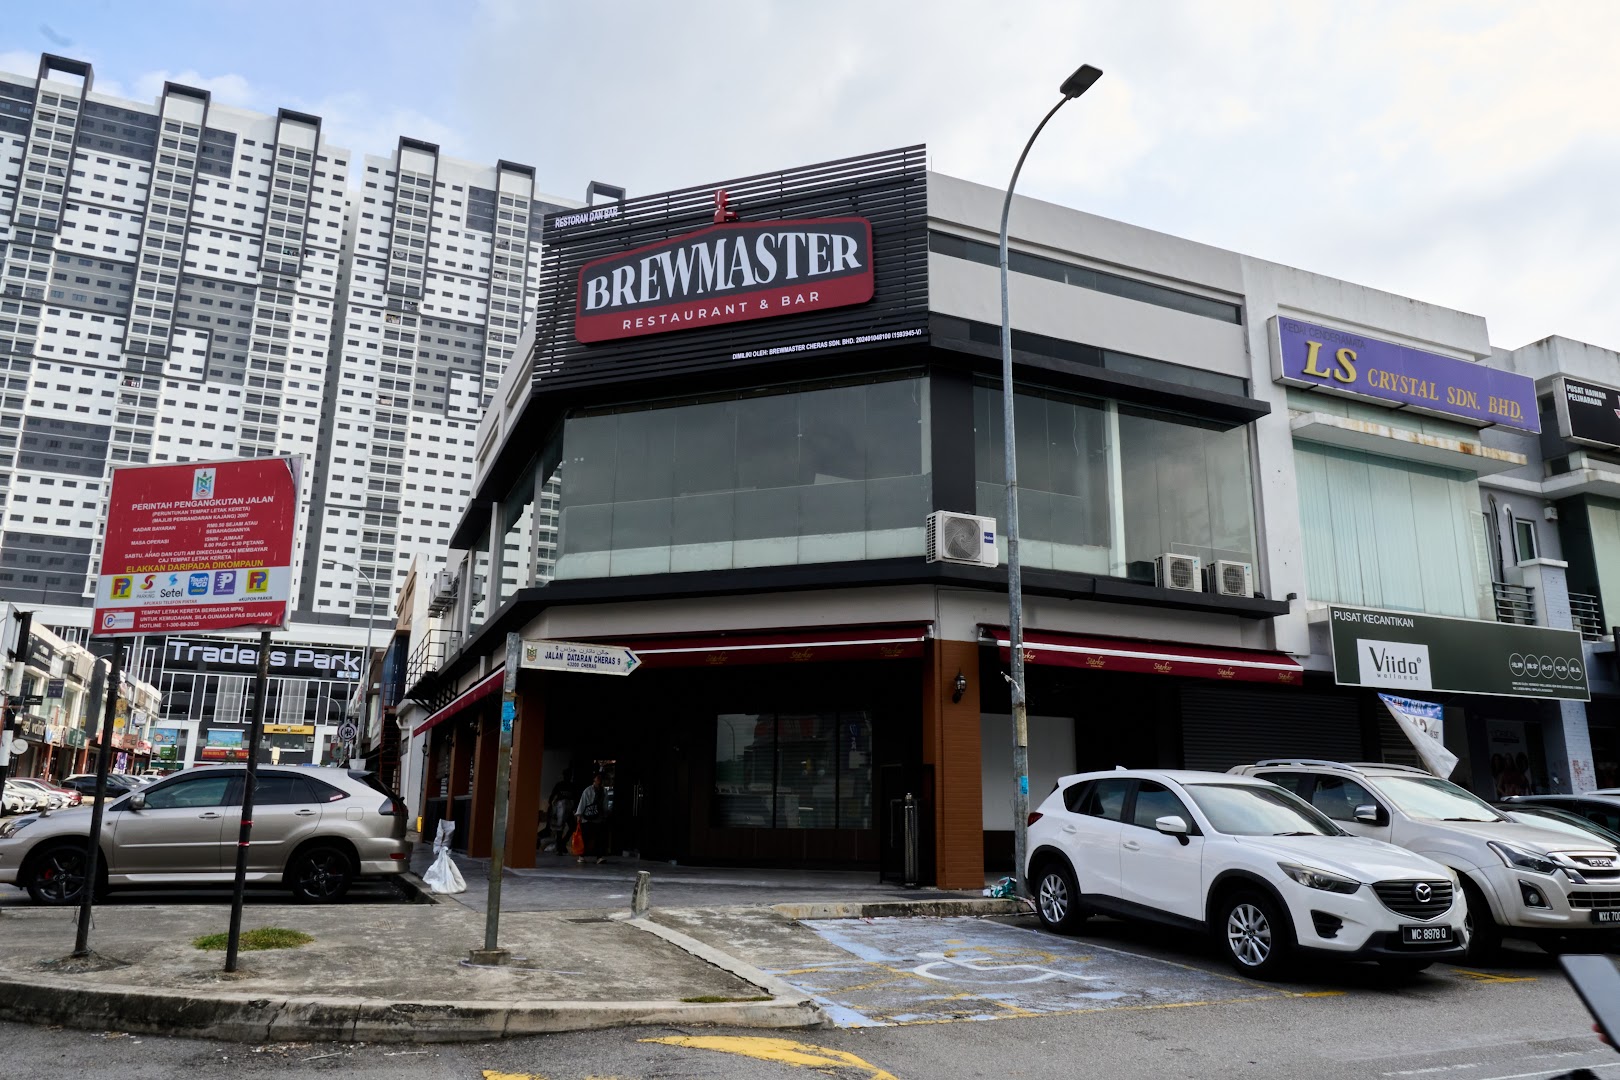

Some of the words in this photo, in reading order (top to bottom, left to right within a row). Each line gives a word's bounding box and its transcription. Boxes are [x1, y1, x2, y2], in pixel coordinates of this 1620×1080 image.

[555, 213, 588, 228] RESTORAN
[589, 211, 603, 222] DAN
[603, 207, 618, 219] BAR
[585, 231, 862, 310] BREWMASTER
[622, 302, 748, 330] RESTAURANT
[760, 299, 769, 310] &
[781, 291, 820, 307] BAR
[1282, 322, 1306, 335] KEDAI
[1309, 328, 1366, 349] CENDERAMATA
[732, 350, 752, 360] DIMILIKI
[753, 349, 769, 358] OLEH:
[769, 344, 806, 356] BREWMASTER
[806, 341, 828, 351] CHERAS
[829, 339, 841, 347] SDN.
[842, 337, 855, 345] BHD.
[1302, 341, 1357, 383] LS
[1367, 368, 1439, 400] CRYSTAL
[1446, 386, 1481, 410] SDN.
[1488, 395, 1524, 419] BHD.
[1566, 384, 1585, 394] PUSAT
[1567, 392, 1602, 407] PELIHARAAN
[132, 501, 173, 511] PERINTAH
[174, 497, 244, 509] PENGANGKUTAN
[245, 495, 274, 505] JALAN
[126, 564, 166, 573] ELAKKAN
[167, 562, 210, 571] DARIPADA
[212, 560, 264, 569] DIKOMPAUN
[160, 588, 184, 598] Setel
[1333, 610, 1361, 622] PUSAT
[1363, 614, 1414, 628] KECANTIKAN
[294, 649, 361, 671] Park
[545, 651, 563, 660] JALAN
[567, 653, 592, 663] DATARAN
[594, 656, 616, 665] CHERAS
[617, 658, 621, 666] 9
[1368, 646, 1418, 675] Viido
[1377, 673, 1419, 681] wellness
[1598, 911, 1611, 922] WXX
[1423, 928, 1441, 940] 8978
[1441, 927, 1447, 939] Q
